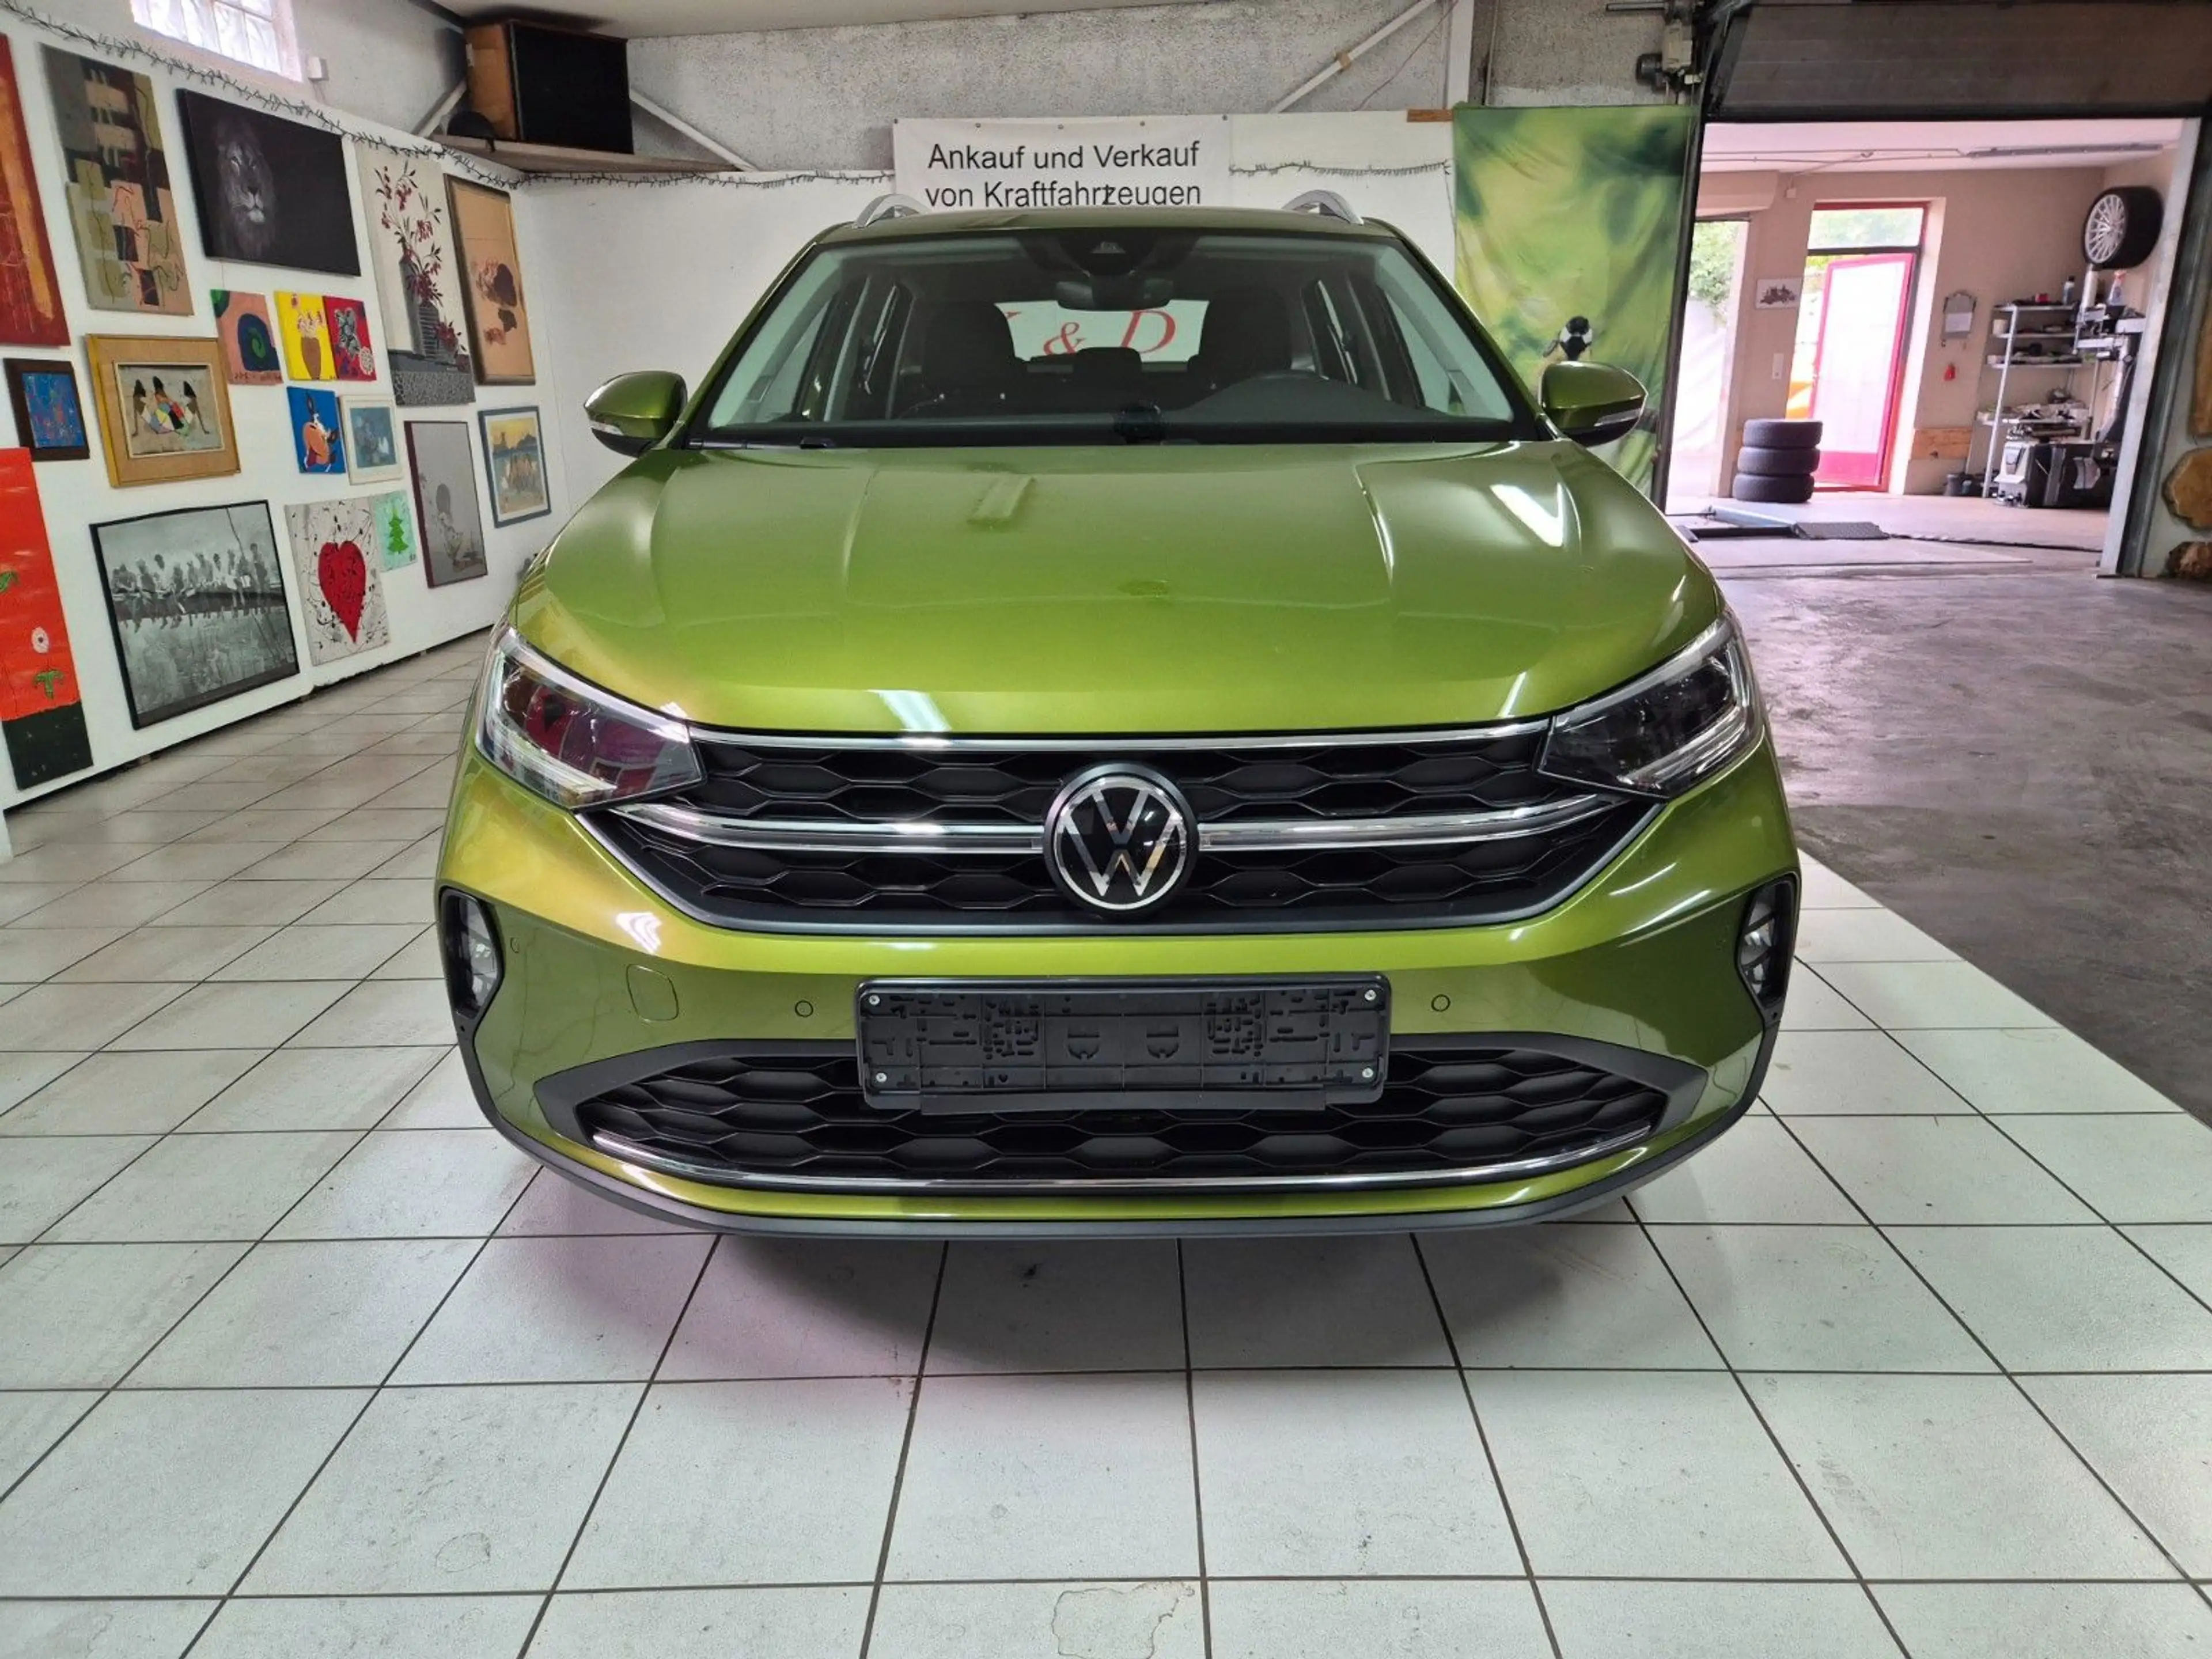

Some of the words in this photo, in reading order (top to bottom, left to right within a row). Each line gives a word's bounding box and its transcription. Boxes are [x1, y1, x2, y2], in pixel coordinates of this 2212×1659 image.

[927, 143, 1026, 169] Ankauf
[1035, 145, 1083, 169] und
[1093, 141, 1200, 168] Verkauf
[925, 188, 973, 207] von
[984, 181, 1200, 207] Kraftfahrzeugen
